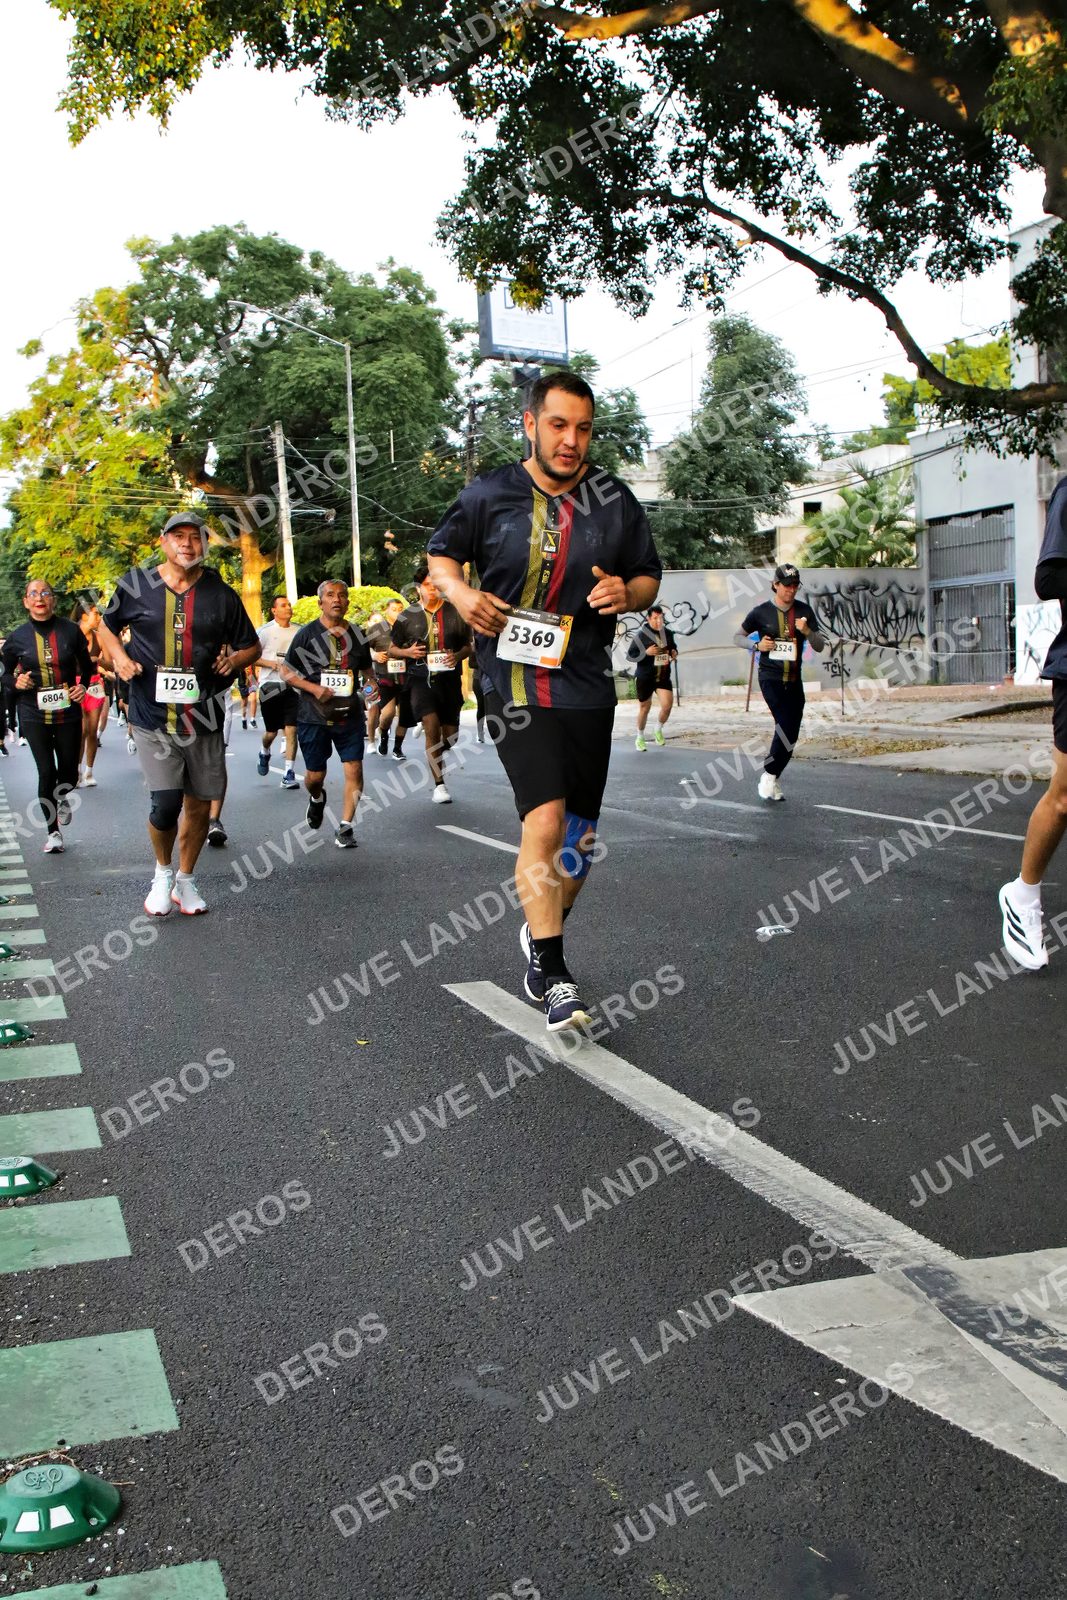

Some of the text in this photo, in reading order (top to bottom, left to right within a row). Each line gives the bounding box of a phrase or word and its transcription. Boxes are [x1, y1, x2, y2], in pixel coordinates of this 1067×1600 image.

[508, 624, 555, 648] 5369
[774, 643, 793, 652] 2524
[163, 678, 194, 691] 1296
[326, 677, 347, 687] 1353
[42, 692, 64, 703] 6804
